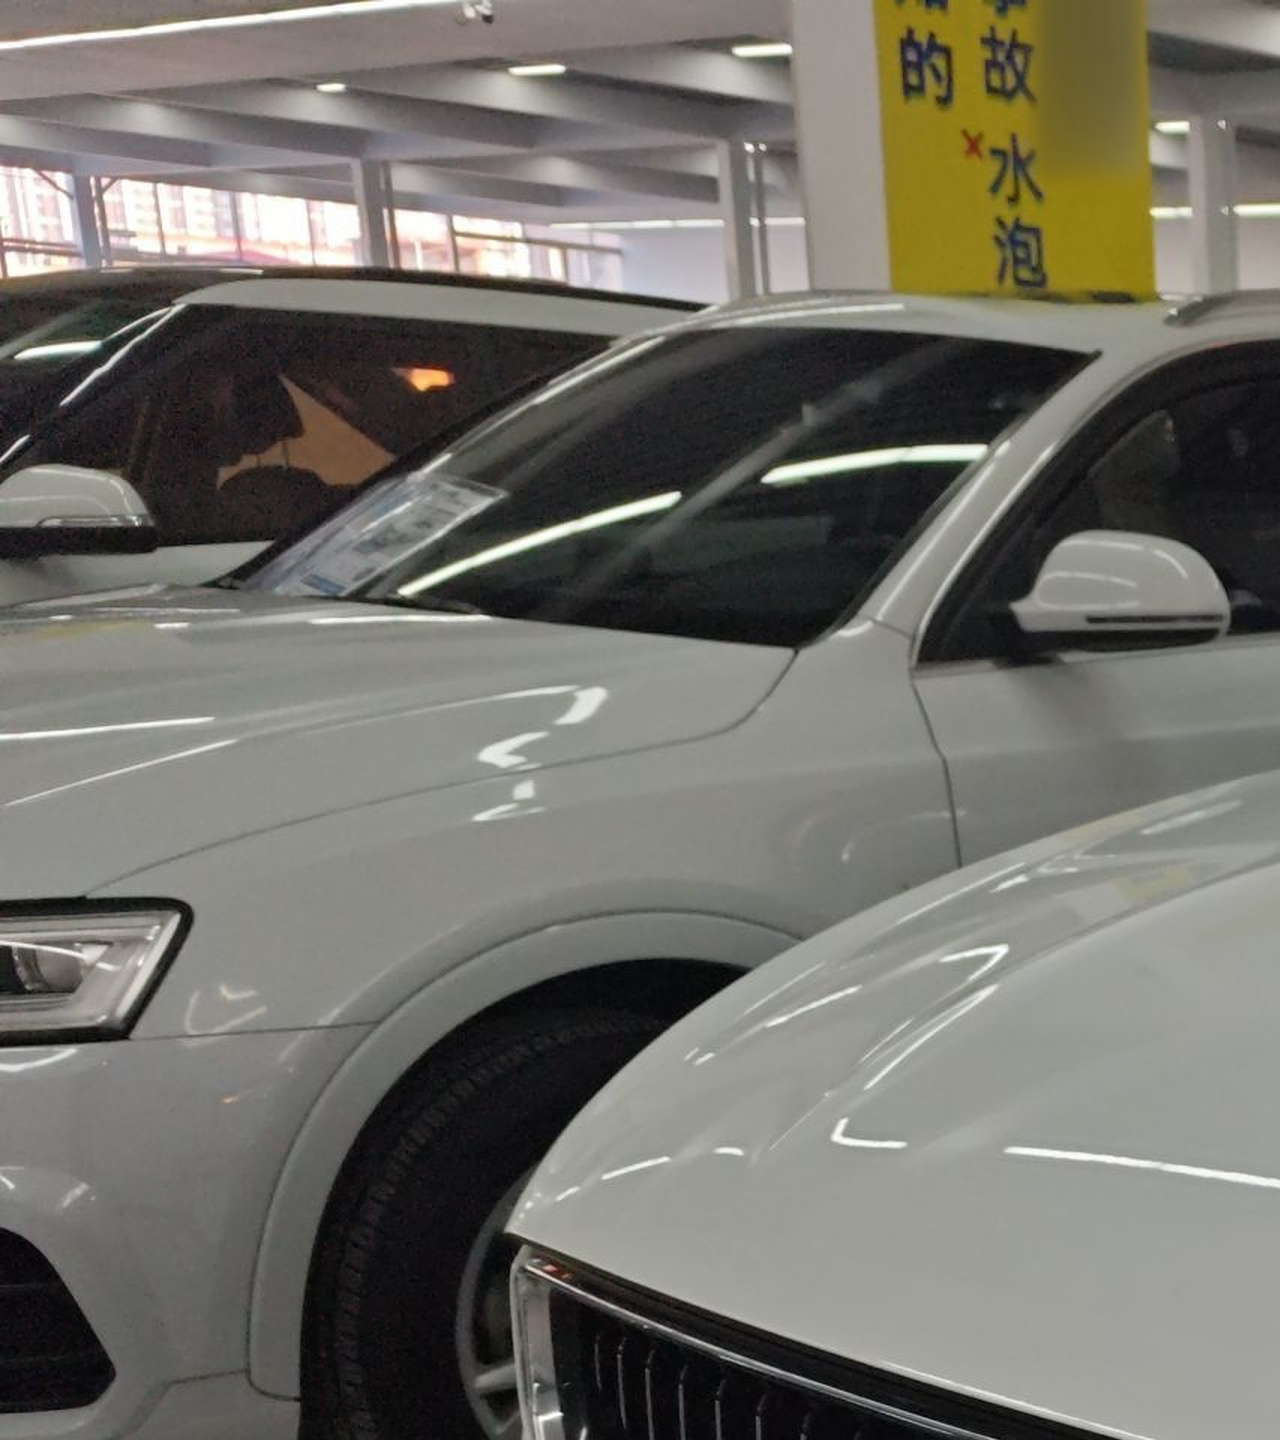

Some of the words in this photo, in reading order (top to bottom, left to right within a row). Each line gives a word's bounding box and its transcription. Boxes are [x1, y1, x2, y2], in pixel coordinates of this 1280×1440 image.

[893, 0, 954, 108] 的
[979, 0, 1047, 288] 故水泡
